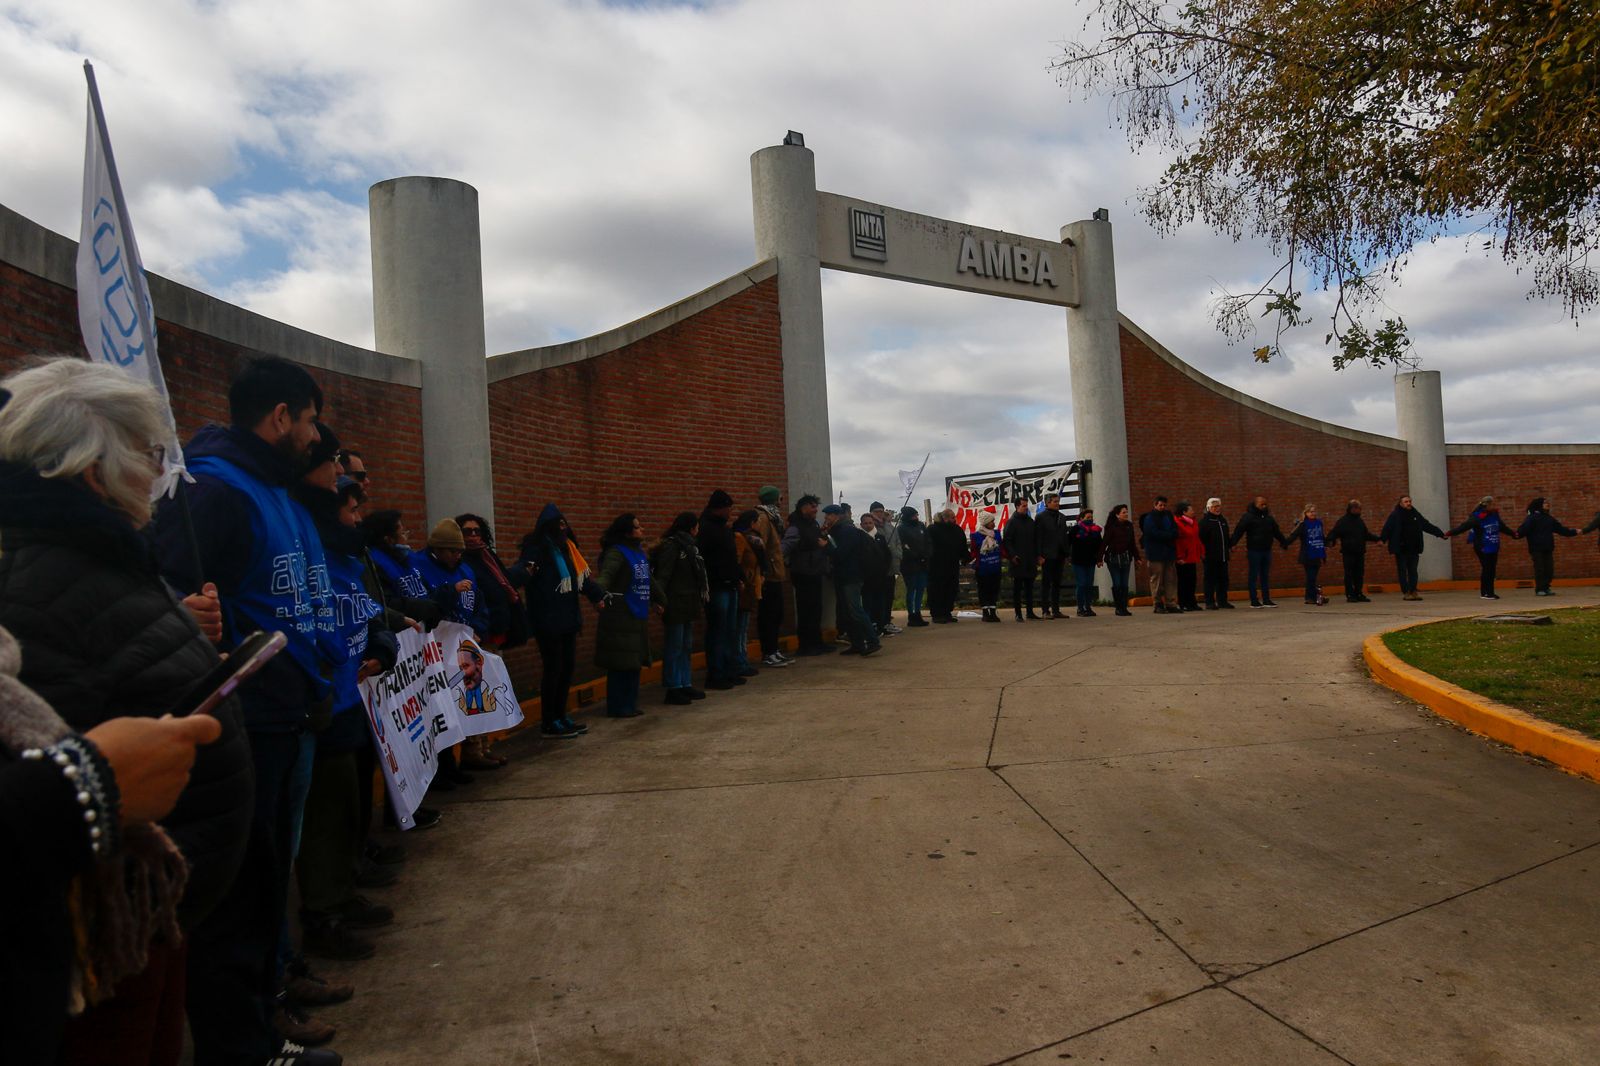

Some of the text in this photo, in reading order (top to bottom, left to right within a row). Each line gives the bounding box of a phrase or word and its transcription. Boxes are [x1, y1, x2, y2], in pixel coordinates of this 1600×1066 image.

[856, 212, 884, 240] INTA
[957, 236, 1058, 287] AMBA
[950, 486, 971, 508] NO
[984, 479, 1044, 507] CIERRE
